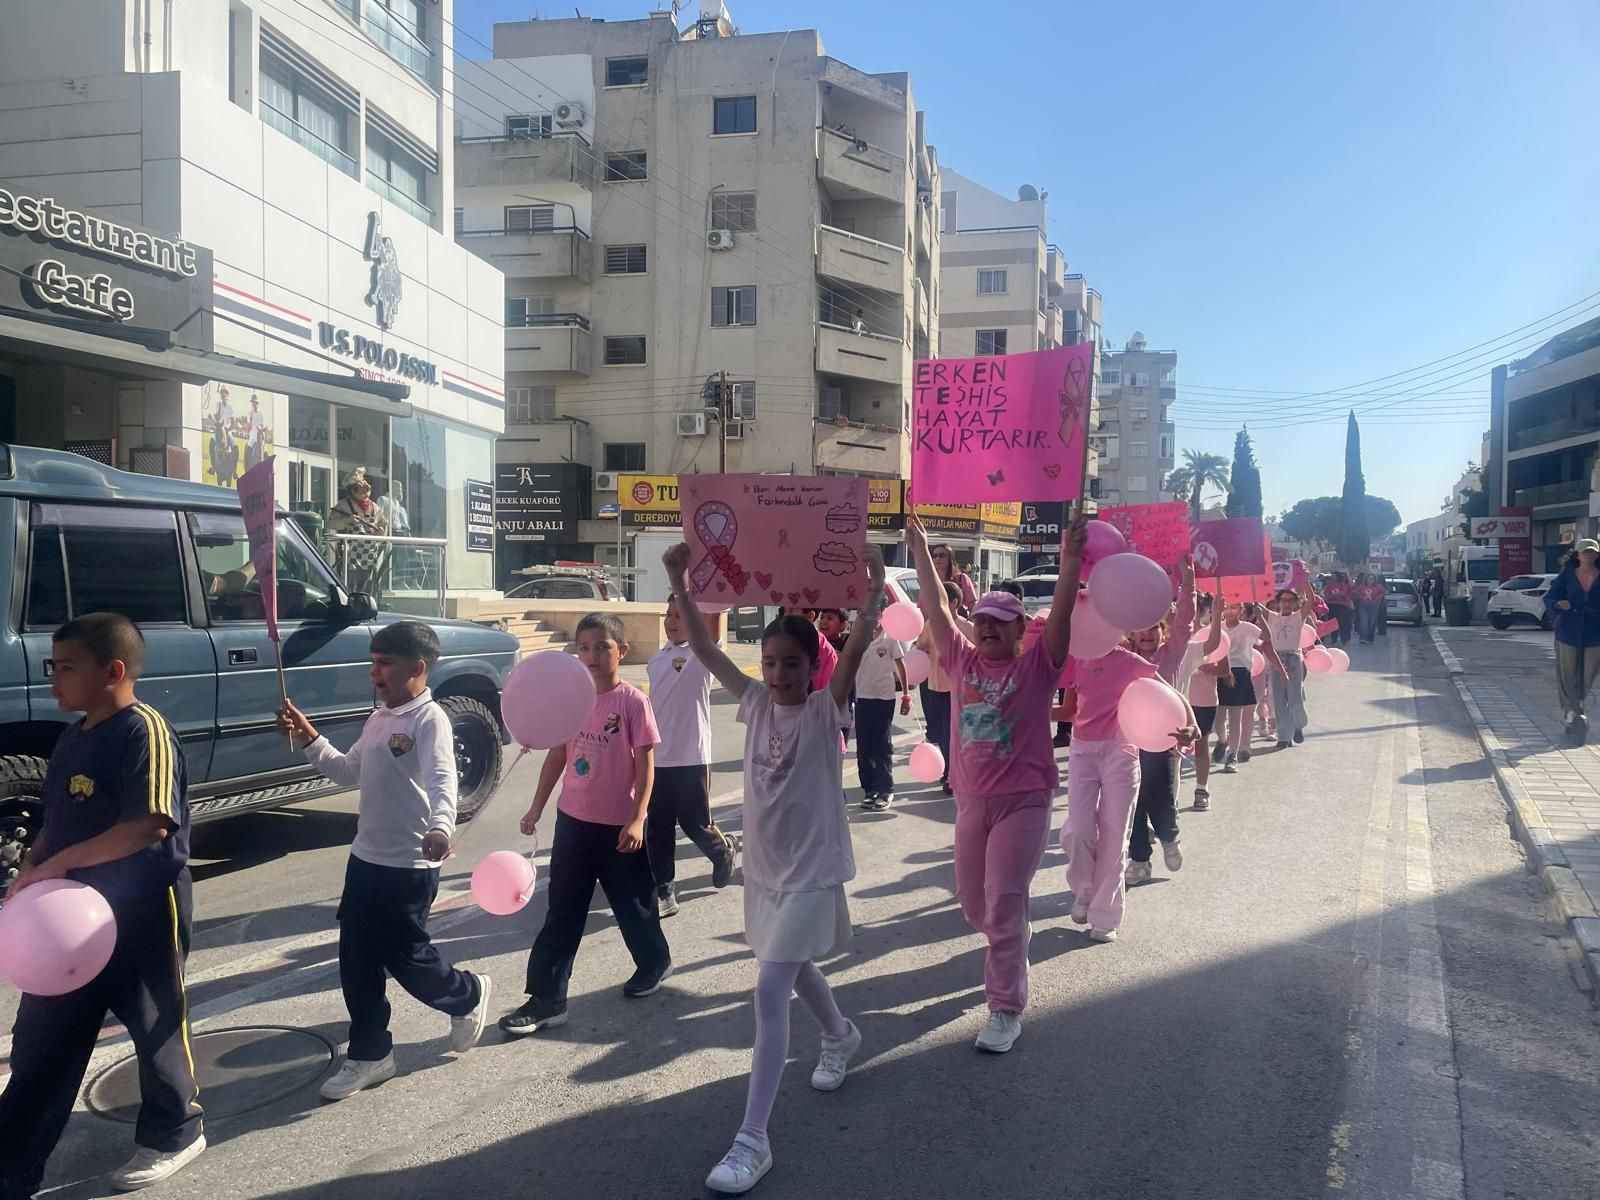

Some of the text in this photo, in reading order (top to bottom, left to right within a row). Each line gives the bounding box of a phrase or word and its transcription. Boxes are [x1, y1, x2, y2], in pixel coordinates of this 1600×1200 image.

[37, 259, 134, 320] Cafe
[317, 321, 439, 387] U.S. POLO ASSN.
[916, 360, 1007, 385] ERKEN
[916, 384, 1007, 408] TEŞHİS
[916, 409, 1007, 428] HAYAT
[916, 428, 1052, 454] KURTARIR.
[520, 497, 561, 505] KUAFÖRÜ
